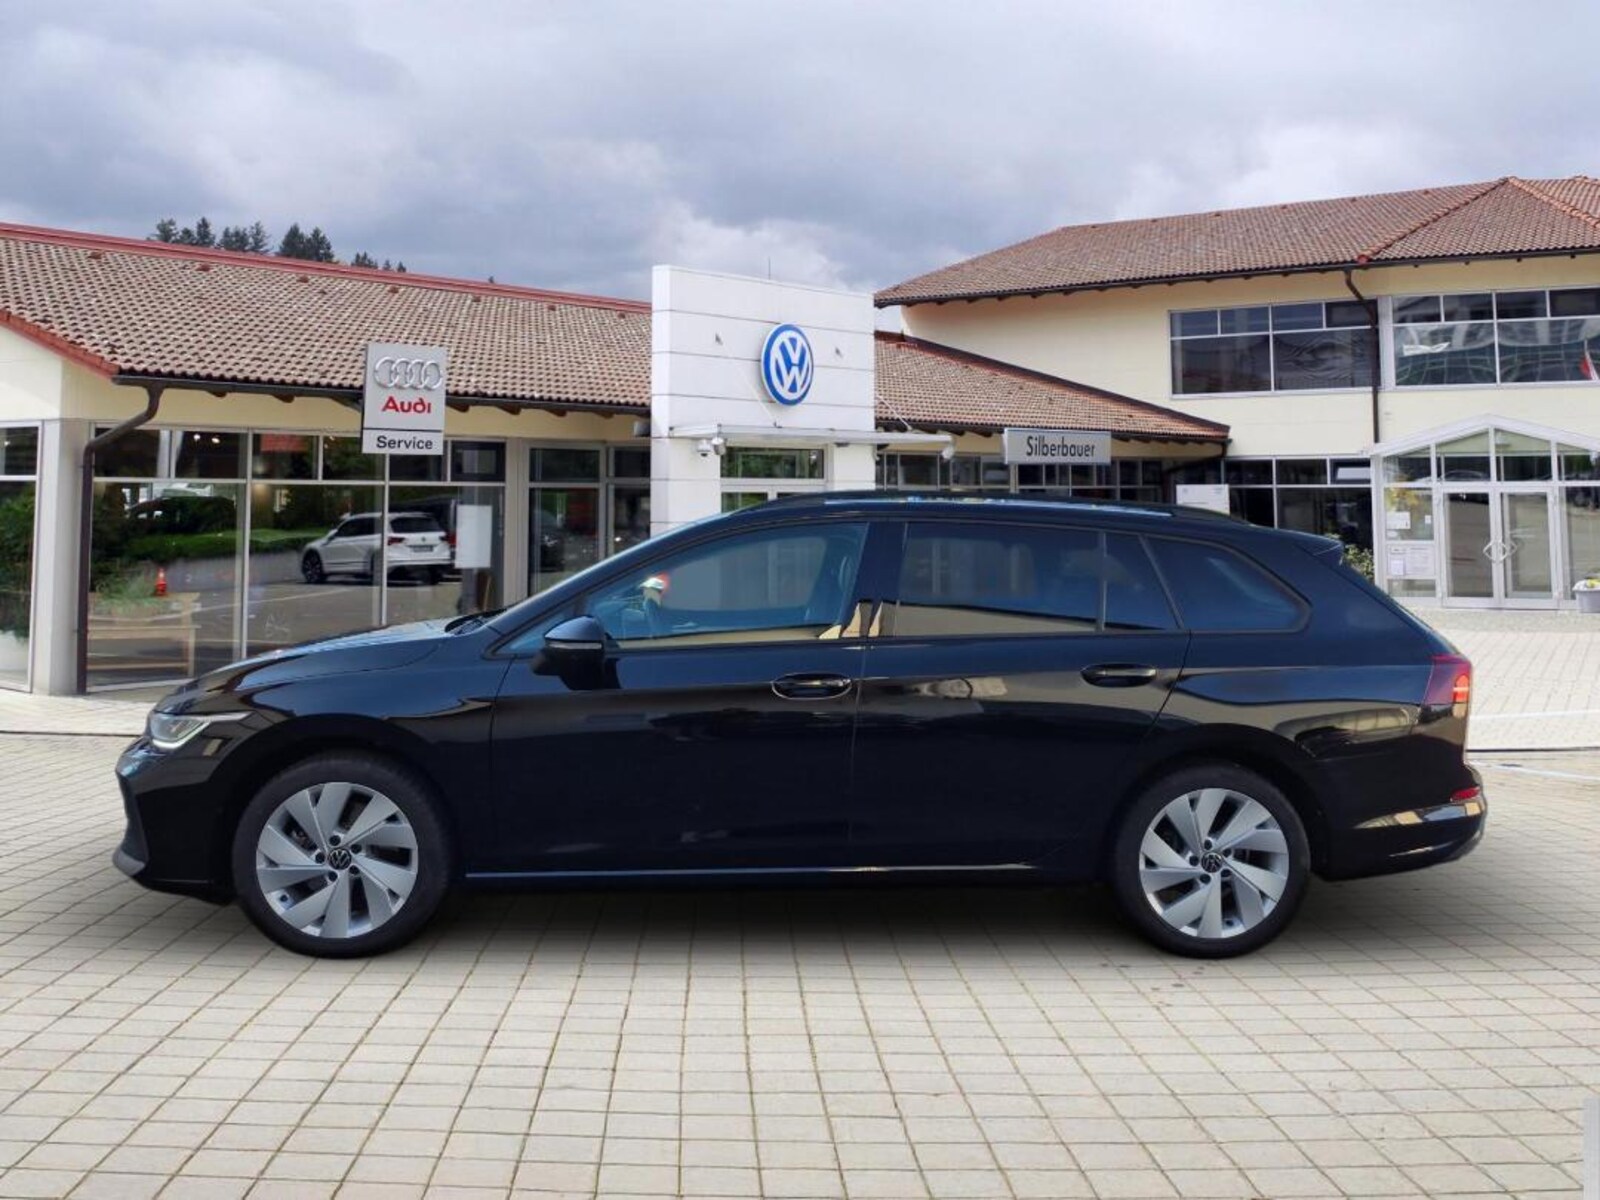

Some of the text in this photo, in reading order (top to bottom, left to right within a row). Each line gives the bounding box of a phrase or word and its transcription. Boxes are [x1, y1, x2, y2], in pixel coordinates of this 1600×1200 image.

[767, 327, 811, 402] VW
[382, 396, 431, 413] Audi
[376, 435, 433, 450] Service
[1026, 436, 1096, 457] Silberbauer
